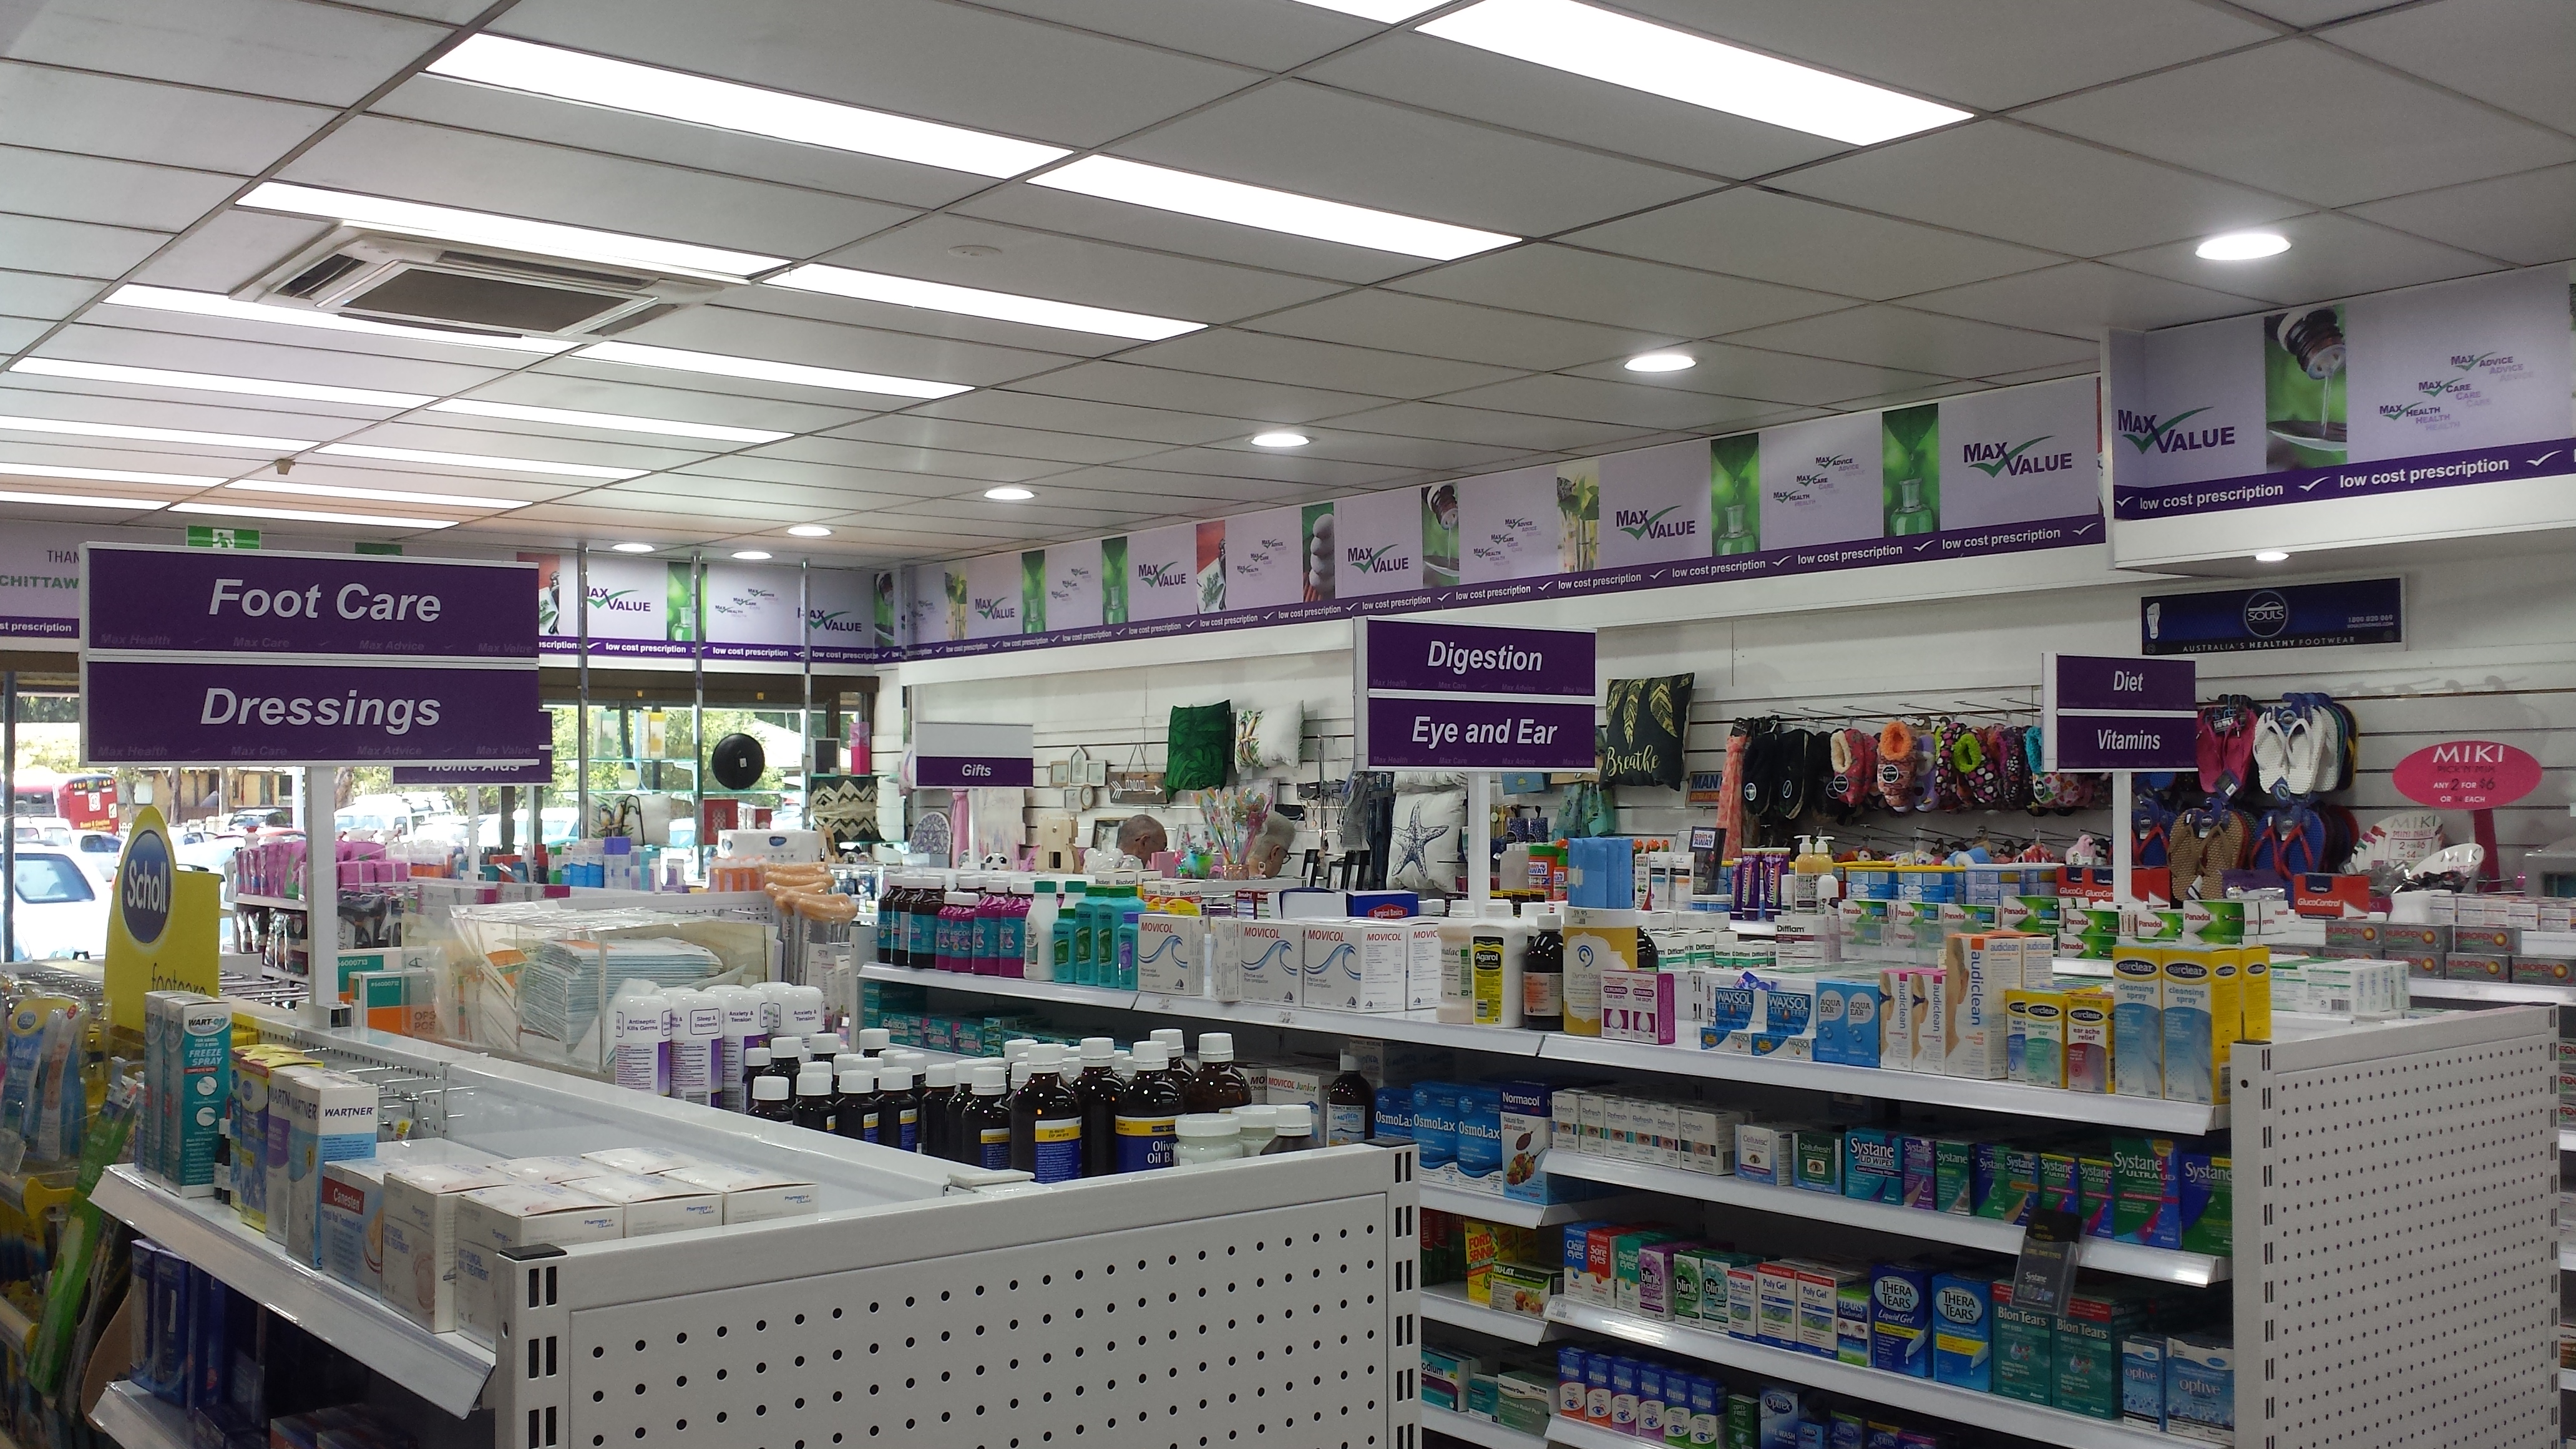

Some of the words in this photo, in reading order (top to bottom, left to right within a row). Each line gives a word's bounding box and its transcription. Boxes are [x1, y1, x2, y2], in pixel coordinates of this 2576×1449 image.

[2451, 354, 2475, 366] MAX
[2479, 356, 2513, 368] ADVICE
[2418, 381, 2442, 391] MAX
[2446, 383, 2471, 394] CARE
[2379, 404, 2402, 414] MAX
[2406, 406, 2440, 417] HEALTH
[2117, 409, 2157, 434] MAX
[2155, 427, 2235, 453] VALUE
[1964, 442, 2008, 462] MAX
[2006, 452, 2072, 476] VALUE
[2339, 473, 2366, 489] low
[2371, 469, 2406, 485] cost
[2409, 457, 2509, 484] prescription
[2139, 497, 2159, 510] low
[2162, 492, 2193, 508] cost
[2197, 483, 2283, 506] prescription
[1616, 509, 1648, 527] MAX
[1647, 520, 1695, 539] VALUE
[1942, 538, 1961, 549] low
[1964, 535, 1988, 547] cost
[1991, 528, 2061, 546] prescription
[1348, 547, 1372, 562] MAX
[1798, 554, 1814, 565] low
[1817, 550, 1839, 562] cost
[1842, 544, 1903, 562] prescription
[1139, 564, 1158, 577] MAX
[1371, 557, 1409, 573] VALUE
[1672, 568, 1687, 578] low
[1689, 565, 1709, 576] cost
[1711, 559, 1766, 575] prescription
[1156, 573, 1186, 587] VALUE
[1558, 580, 1573, 590] low
[1573, 578, 1591, 588] cost
[1593, 572, 1641, 588] prescription
[1456, 591, 1469, 601] low
[1470, 588, 1486, 600] cost
[1488, 584, 1531, 600] prescription
[208, 578, 323, 619] Foot
[336, 583, 441, 622] Care
[608, 597, 651, 612] VALUE
[1362, 601, 1373, 610] low
[1375, 600, 1389, 610] cost
[1390, 595, 1432, 609] prescription
[1224, 614, 1258, 625] prescription
[2248, 610, 2285, 622] SOULS
[11, 622, 72, 633] prescription
[824, 620, 862, 632] VALUE
[605, 642, 620, 652] low
[622, 643, 638, 653] cost
[640, 644, 686, 655] prescription
[2183, 643, 2245, 652] AUSTRALIA'S
[2249, 640, 2295, 648] HEALTHY
[2299, 636, 2355, 645] FOOTWEAR
[713, 646, 726, 655] low
[745, 648, 789, 657] prescription
[1427, 641, 1543, 675] Digestion
[2113, 670, 2144, 692] Diet
[200, 688, 441, 735] Dressings
[1412, 716, 1458, 749] Eye
[1465, 718, 1511, 744] and
[1517, 718, 1558, 744] Ear
[2097, 729, 2161, 751] Vitamins
[1606, 744, 1660, 777] Breathe
[2433, 744, 2504, 763] MIKI
[962, 763, 992, 777] Gifts
[2451, 779, 2459, 791] 2
[2479, 778, 2496, 791] $6
[1693, 838, 1713, 847] AWAY
[1694, 832, 1707, 841] pain
[127, 859, 167, 914] Scholl
[2297, 898, 2340, 907] GlucoControl
[2004, 907, 2027, 915] Panadol
[2185, 912, 2211, 921] Panadol
[1141, 922, 1173, 934] MOVICOL
[1777, 925, 1805, 933] Difflam
[2067, 918, 2089, 927] Panadol
[1244, 927, 1280, 939] MOVICOL
[1308, 930, 1344, 942] MOVICOL
[1367, 933, 1402, 941] MOVICOL
[1990, 944, 2019, 952] audiclean
[1476, 953, 1498, 962] Agarol
[2119, 962, 2154, 972] earclear
[2169, 965, 2205, 976] earclear
[1971, 951, 1981, 1025] audiclean
[2119, 985, 2154, 995] cleansing
[2169, 987, 2205, 997] cleansing
[1716, 990, 1753, 1005] WAXSOL
[1768, 995, 1808, 1011] WAXSOL
[2126, 992, 2147, 1002] spray
[2177, 995, 2197, 1004] spray
[1820, 1005, 1835, 1013] EAR
[1850, 1001, 1871, 1010] AQUA
[189, 1048, 222, 1058] FREEZE
[192, 1056, 223, 1066] SPRAY
[1268, 1077, 1294, 1088] MOVICOL
[1296, 1081, 1317, 1092] Junior
[1503, 1092, 1539, 1106] Normacol
[324, 1107, 374, 1117] WARTNER
[1554, 1105, 1574, 1115] Refresh
[1413, 1114, 1455, 1132] OsmoLax
[1459, 1121, 1500, 1139] OsmoLax
[1743, 1135, 1768, 1146] Celluvisc
[1799, 1143, 1830, 1154] Cellufresh
[1850, 1138, 1895, 1159] Systane
[1147, 1153, 1161, 1164] Oil
[1873, 1158, 1893, 1166] WIPES
[1937, 1151, 1968, 1165] Systane
[2114, 1152, 2163, 1173] Systane
[2041, 1160, 2073, 1175] Systane
[2126, 1171, 2159, 1179] ULTRA
[333, 1188, 360, 1211] Canesten
[1567, 1240, 1584, 1252] Clear
[1590, 1245, 1607, 1257] Sore
[1568, 1249, 1583, 1260] eyes
[1591, 1254, 1606, 1266] eyes
[1641, 1270, 1660, 1284] blink
[1676, 1279, 1697, 1294] blink
[1763, 1279, 1775, 1288] Poly
[1775, 1281, 1787, 1290] Gel
[1881, 1280, 1913, 1297] THERA
[1881, 1295, 1911, 1310] TEARS
[1944, 1290, 1975, 1309] THERA
[1878, 1309, 1899, 1322] Liquid
[1900, 1312, 1915, 1324] Gel
[1945, 1305, 1974, 1320] TEARS
[1998, 1307, 2018, 1322] Bion
[2019, 1311, 2047, 1327] Tears
[2057, 1318, 2078, 1334] Bion
[2079, 1322, 2107, 1340] Tears
[2125, 1367, 2157, 1381] optive
[2179, 1378, 2221, 1397] optive
[1766, 1395, 1790, 1412] Optrex
[1780, 1429, 1795, 1440] WASH
